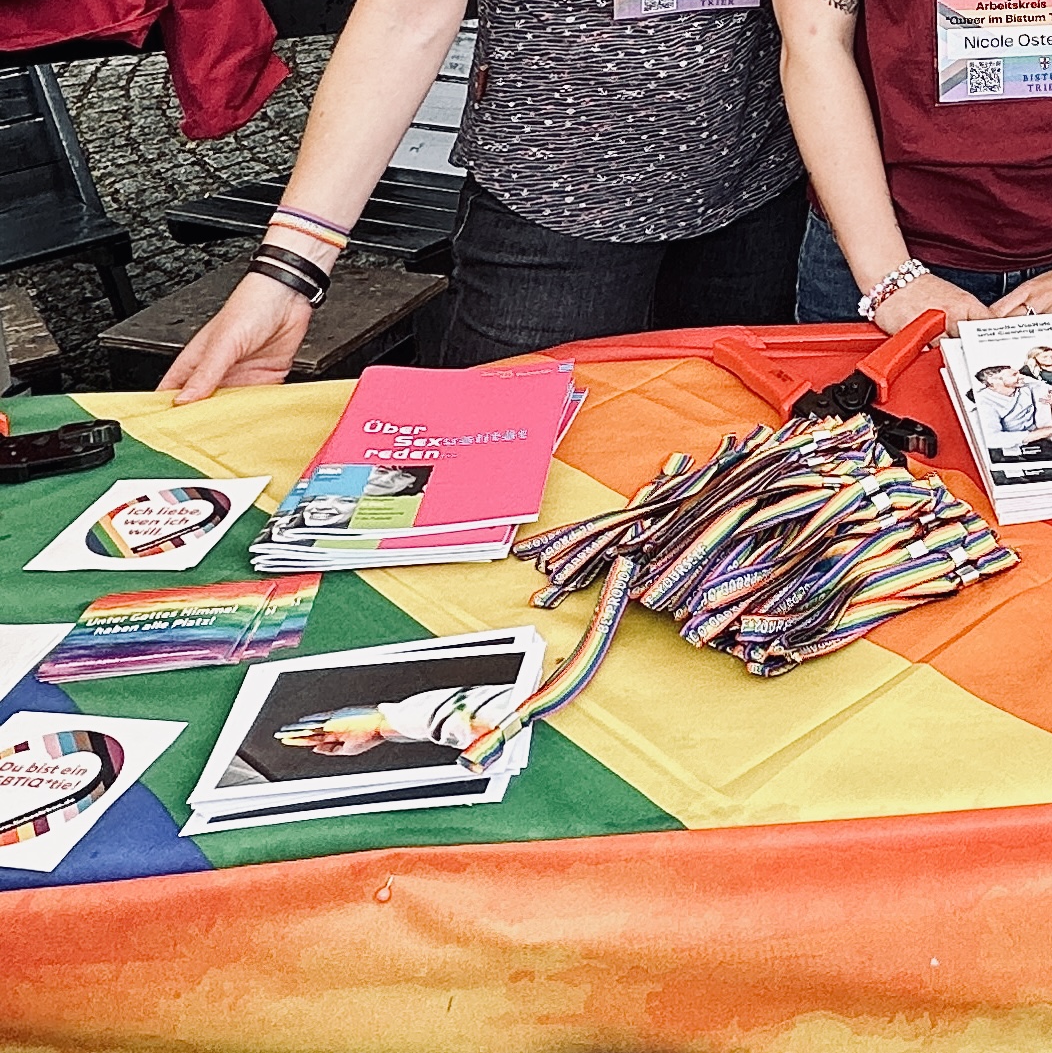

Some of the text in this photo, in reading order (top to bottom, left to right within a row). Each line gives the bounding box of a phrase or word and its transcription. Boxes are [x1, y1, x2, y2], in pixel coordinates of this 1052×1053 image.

[701, 0, 734, 7] TRIER
[976, 0, 1047, 11] Arbeitskreis
[989, 14, 1003, 24] im
[1006, 13, 1046, 23] Bistum
[964, 34, 1013, 49] Nicole
[363, 419, 427, 435] Über
[127, 506, 202, 516] Ich liebe,
[164, 517, 190, 525] ich
[85, 604, 239, 627] Unter Gottes Himmel
[93, 616, 217, 636] haben alle Platz!
[0, 761, 89, 776] Du bist ein
